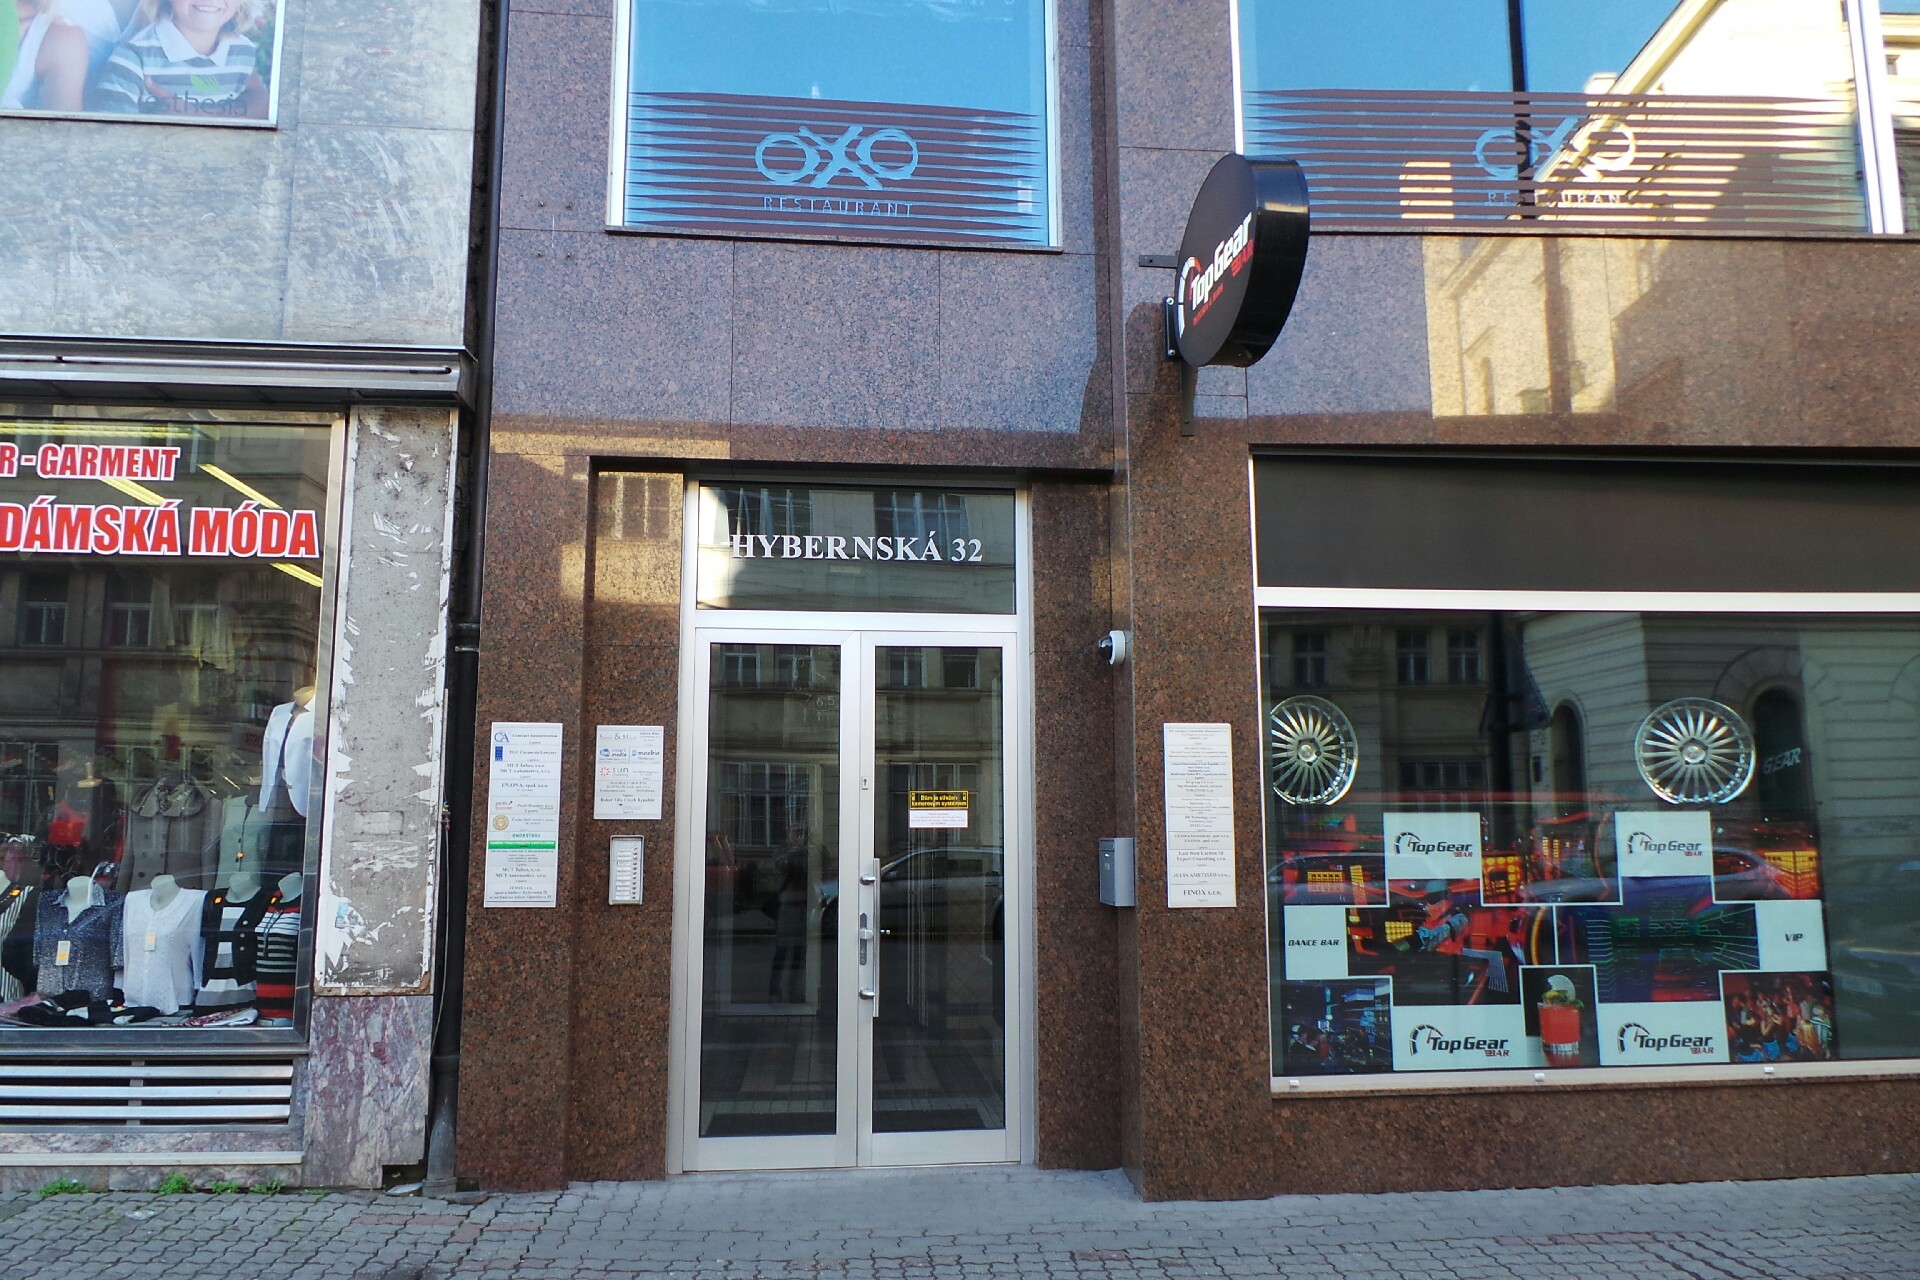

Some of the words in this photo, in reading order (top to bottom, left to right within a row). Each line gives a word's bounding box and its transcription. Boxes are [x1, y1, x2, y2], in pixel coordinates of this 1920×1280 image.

[755, 124, 918, 190] OXO
[763, 196, 913, 217] RESTAURANT
[38, 445, 181, 481] GARMENT
[0, 495, 182, 556] DÁMSKÁ
[188, 500, 319, 558] MÓDA
[730, 530, 943, 561] HYBERNSKÁ
[951, 538, 983, 562] 32
[1785, 933, 1803, 942] VIP
